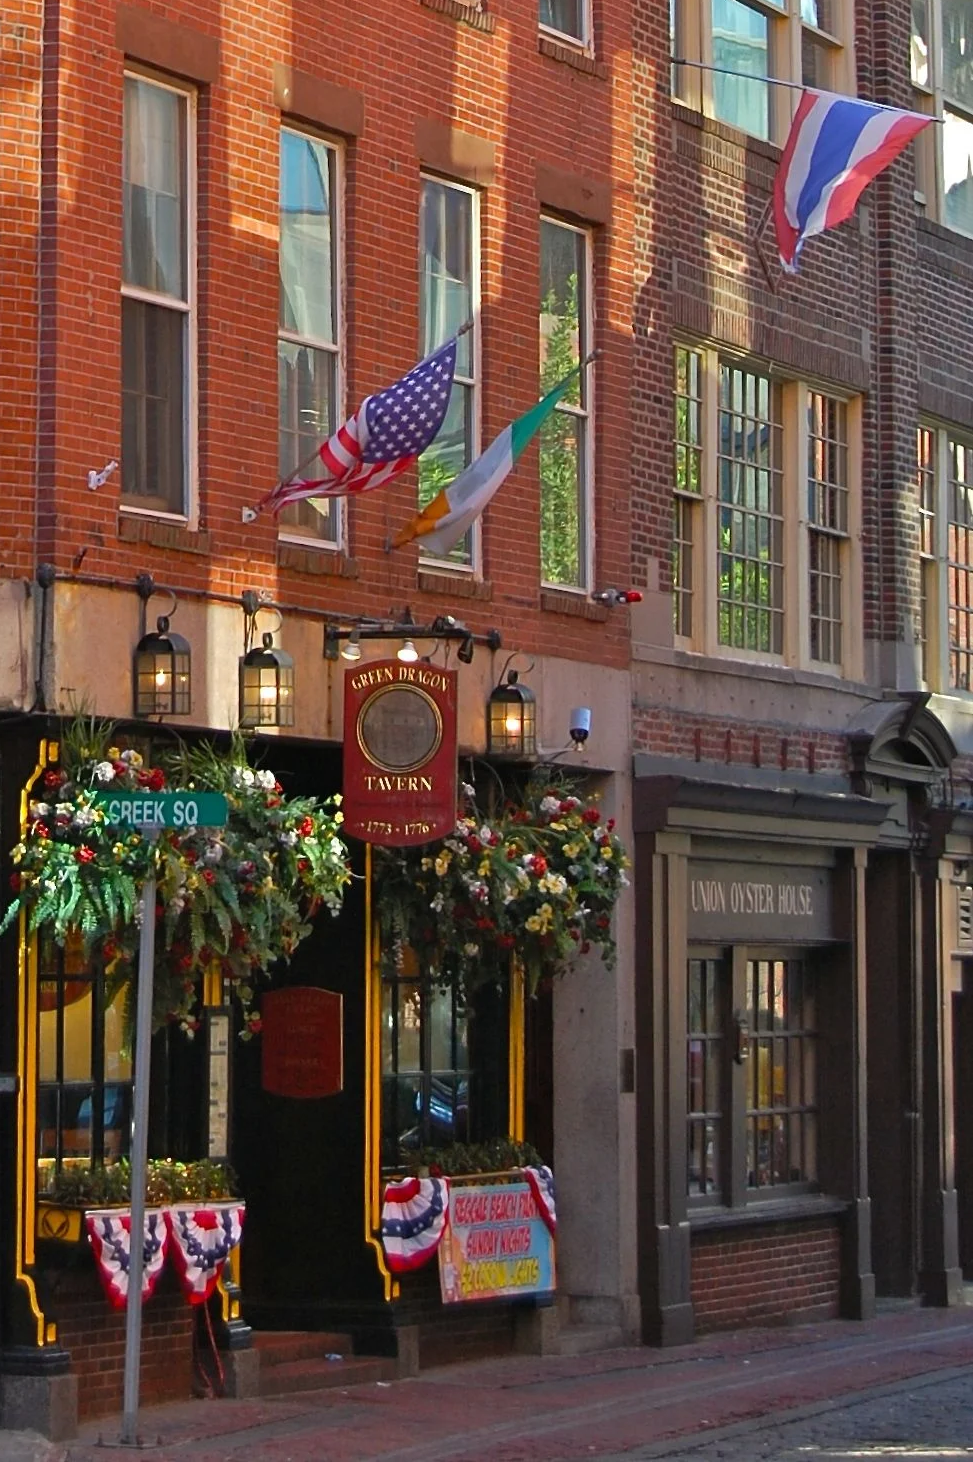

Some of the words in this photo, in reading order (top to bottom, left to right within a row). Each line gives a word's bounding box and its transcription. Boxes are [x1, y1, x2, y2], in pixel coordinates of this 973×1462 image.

[351, 666, 394, 691] GREEN
[398, 666, 450, 693] DRAGON
[364, 776, 433, 792] TAVERN
[109, 799, 166, 825] CREEK
[173, 800, 199, 825] SQ
[366, 821, 392, 836] 1773
[404, 822, 430, 836] 1776
[691, 880, 726, 914] UNION
[730, 882, 774, 914] OYSTER
[778, 884, 813, 915] HOUSE
[467, 1228, 499, 1258] SUNDAY
[500, 1225, 531, 1255] NIGHTS
